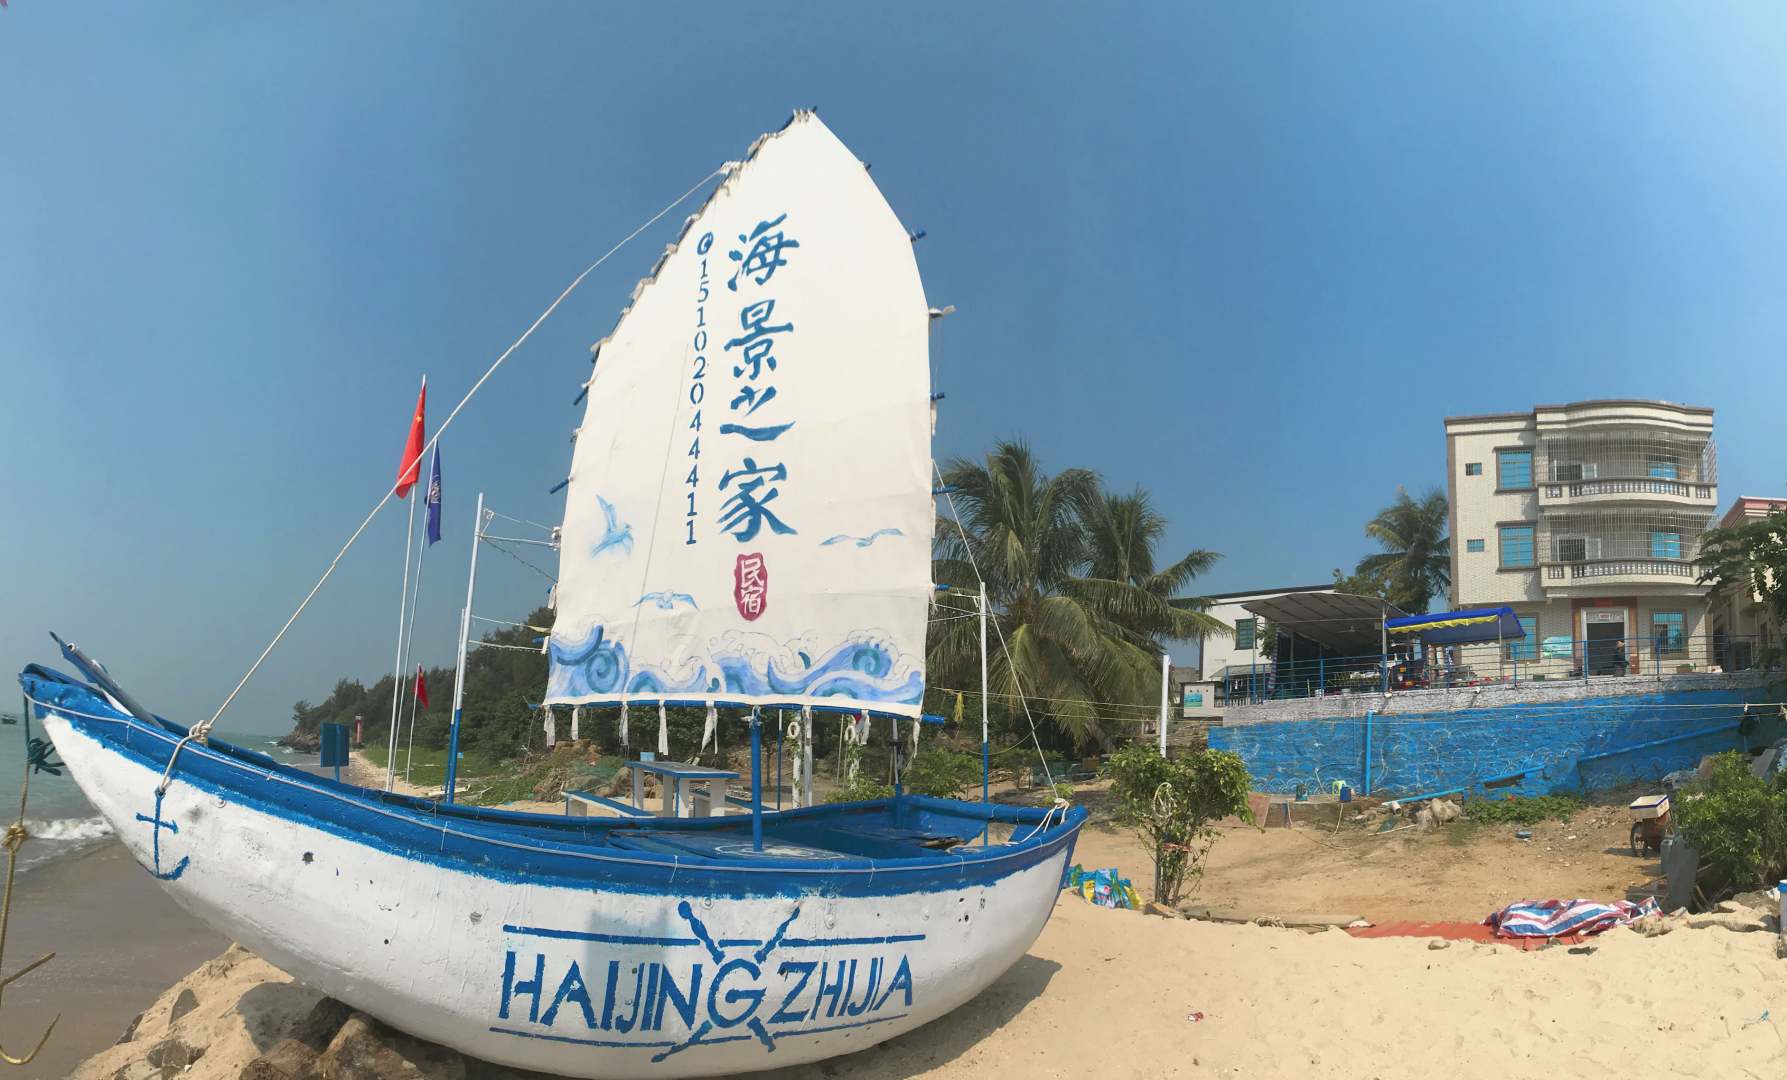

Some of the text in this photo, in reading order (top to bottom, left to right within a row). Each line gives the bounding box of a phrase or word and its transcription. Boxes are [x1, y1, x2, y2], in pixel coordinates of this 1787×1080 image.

[684, 258, 709, 545] 15102044411
[717, 213, 800, 543] 海景之家
[740, 558, 765, 615] 民宿
